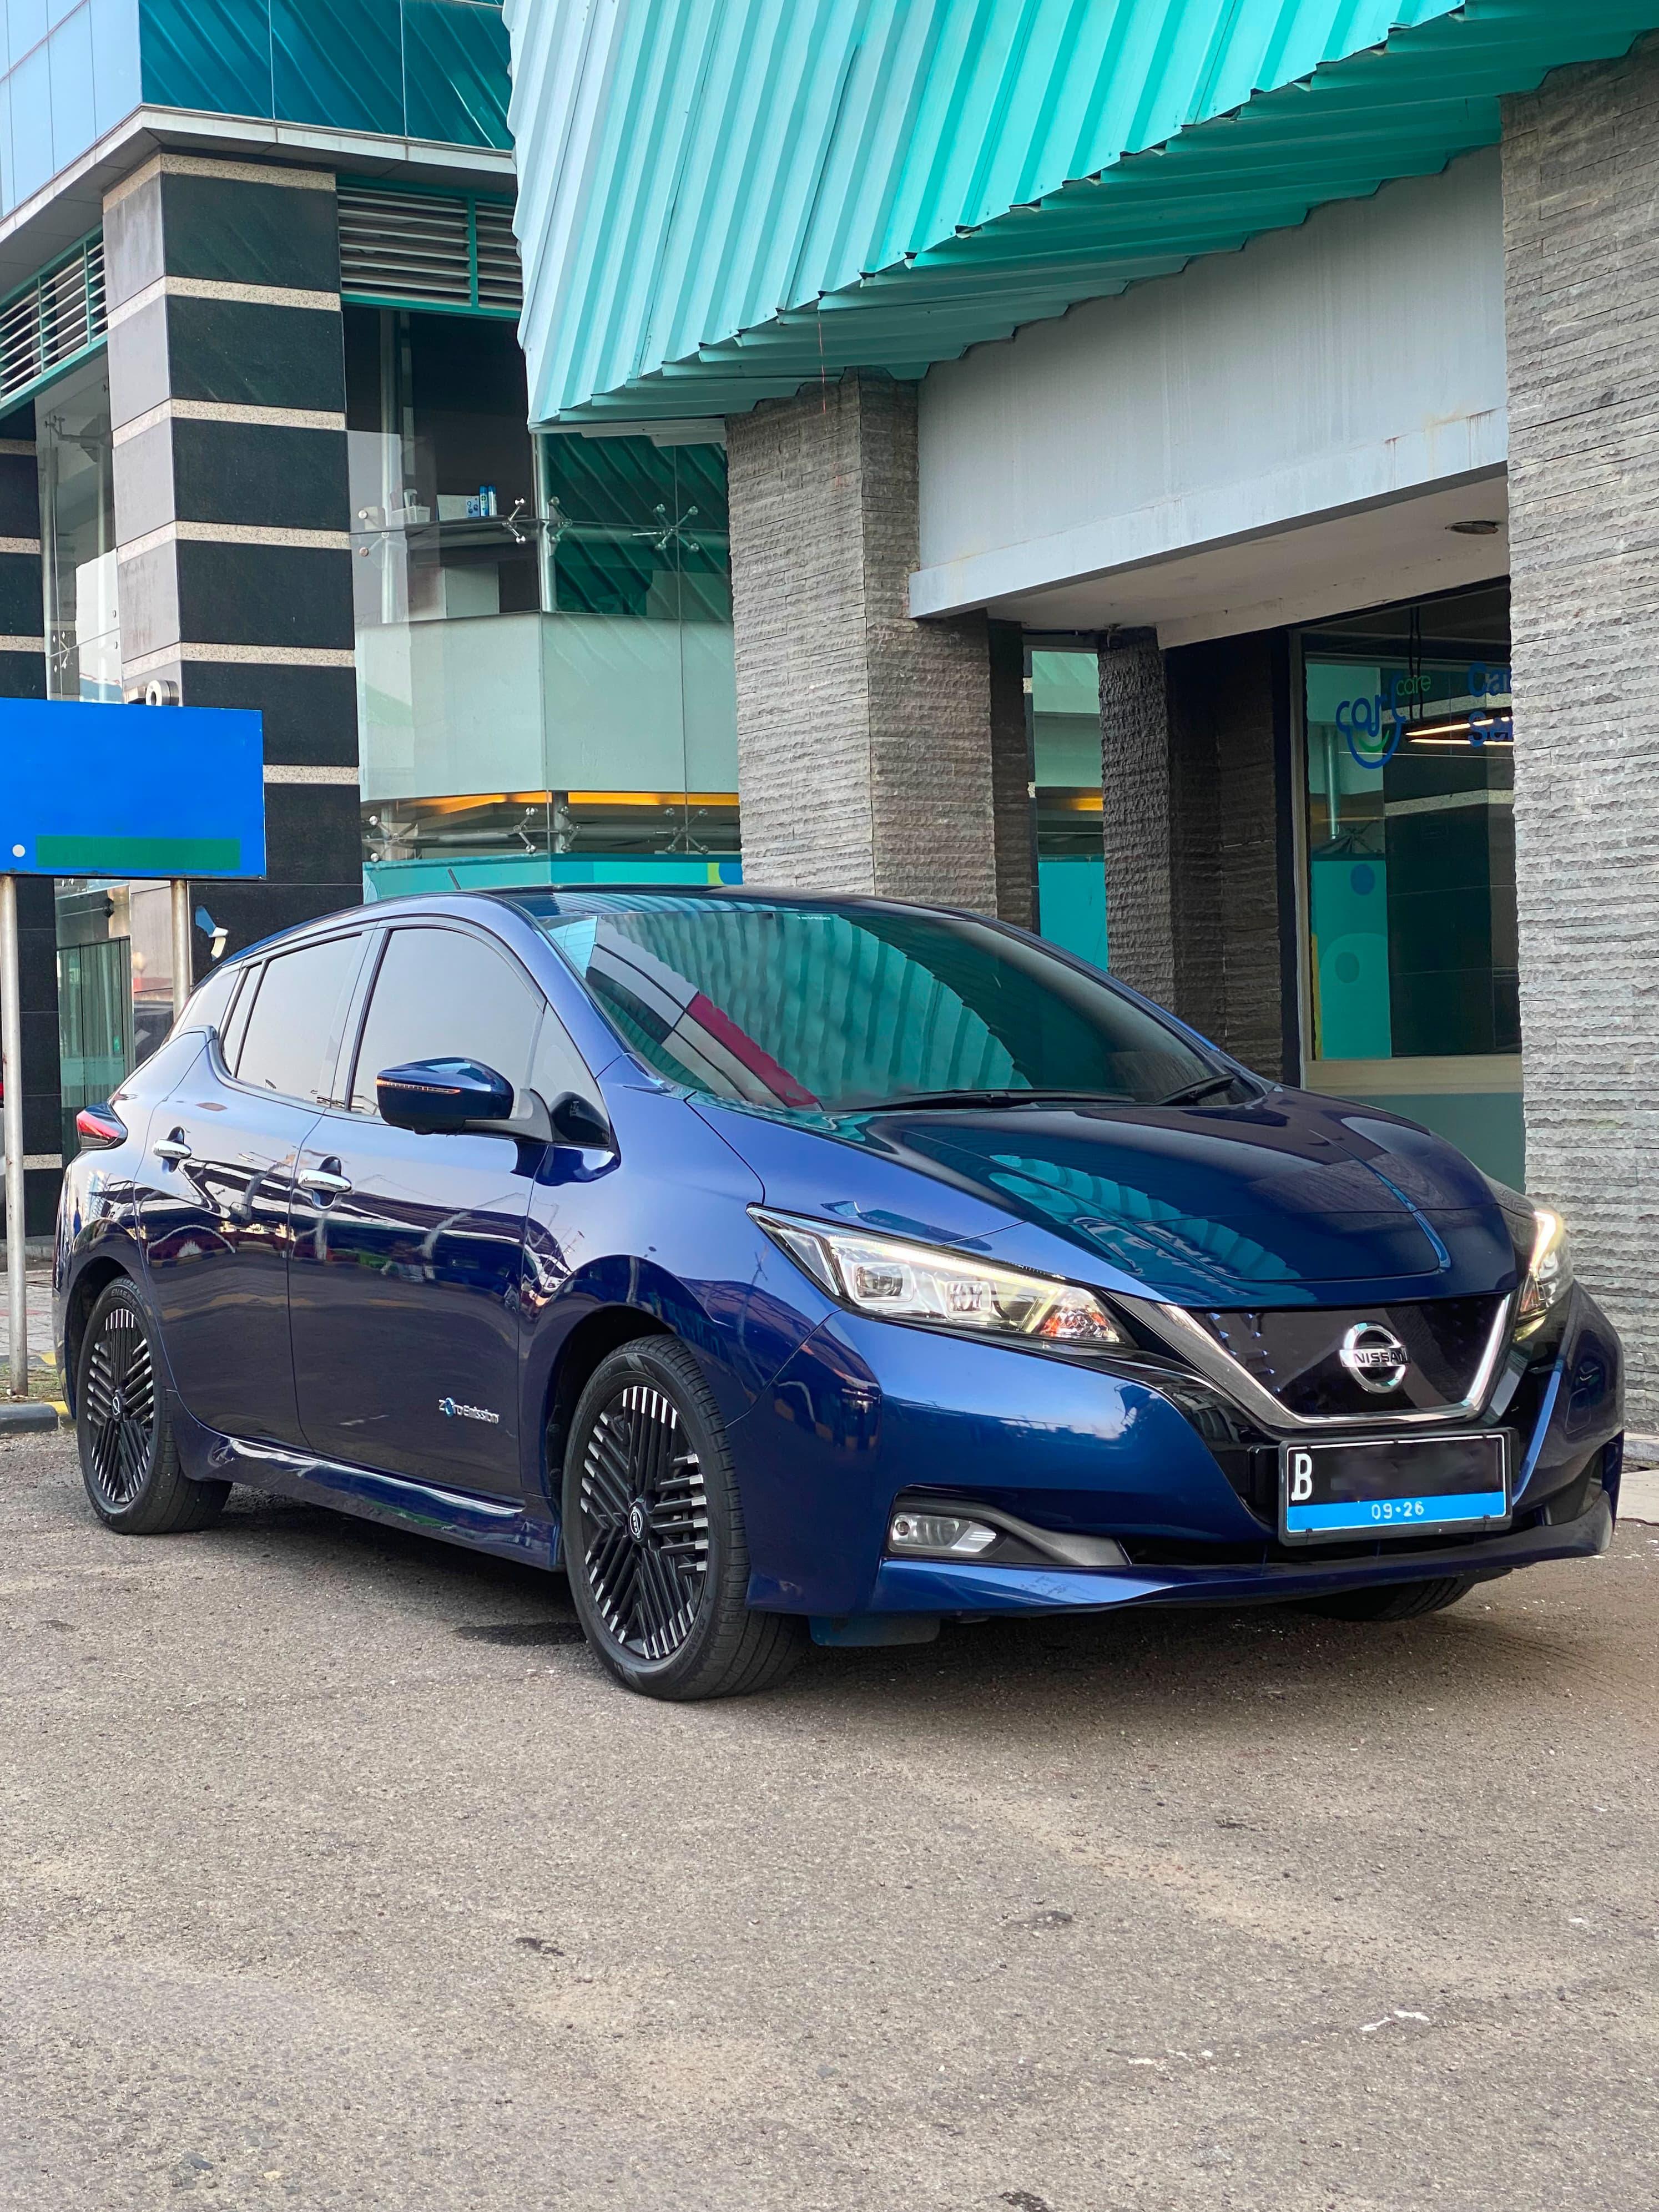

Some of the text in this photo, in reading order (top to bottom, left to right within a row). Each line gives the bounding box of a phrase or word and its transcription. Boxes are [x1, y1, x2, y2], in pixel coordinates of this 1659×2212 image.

[1396, 675, 1431, 696] care
[1355, 1349, 1410, 1364] NISSAN
[1291, 1453, 1313, 1501] B
